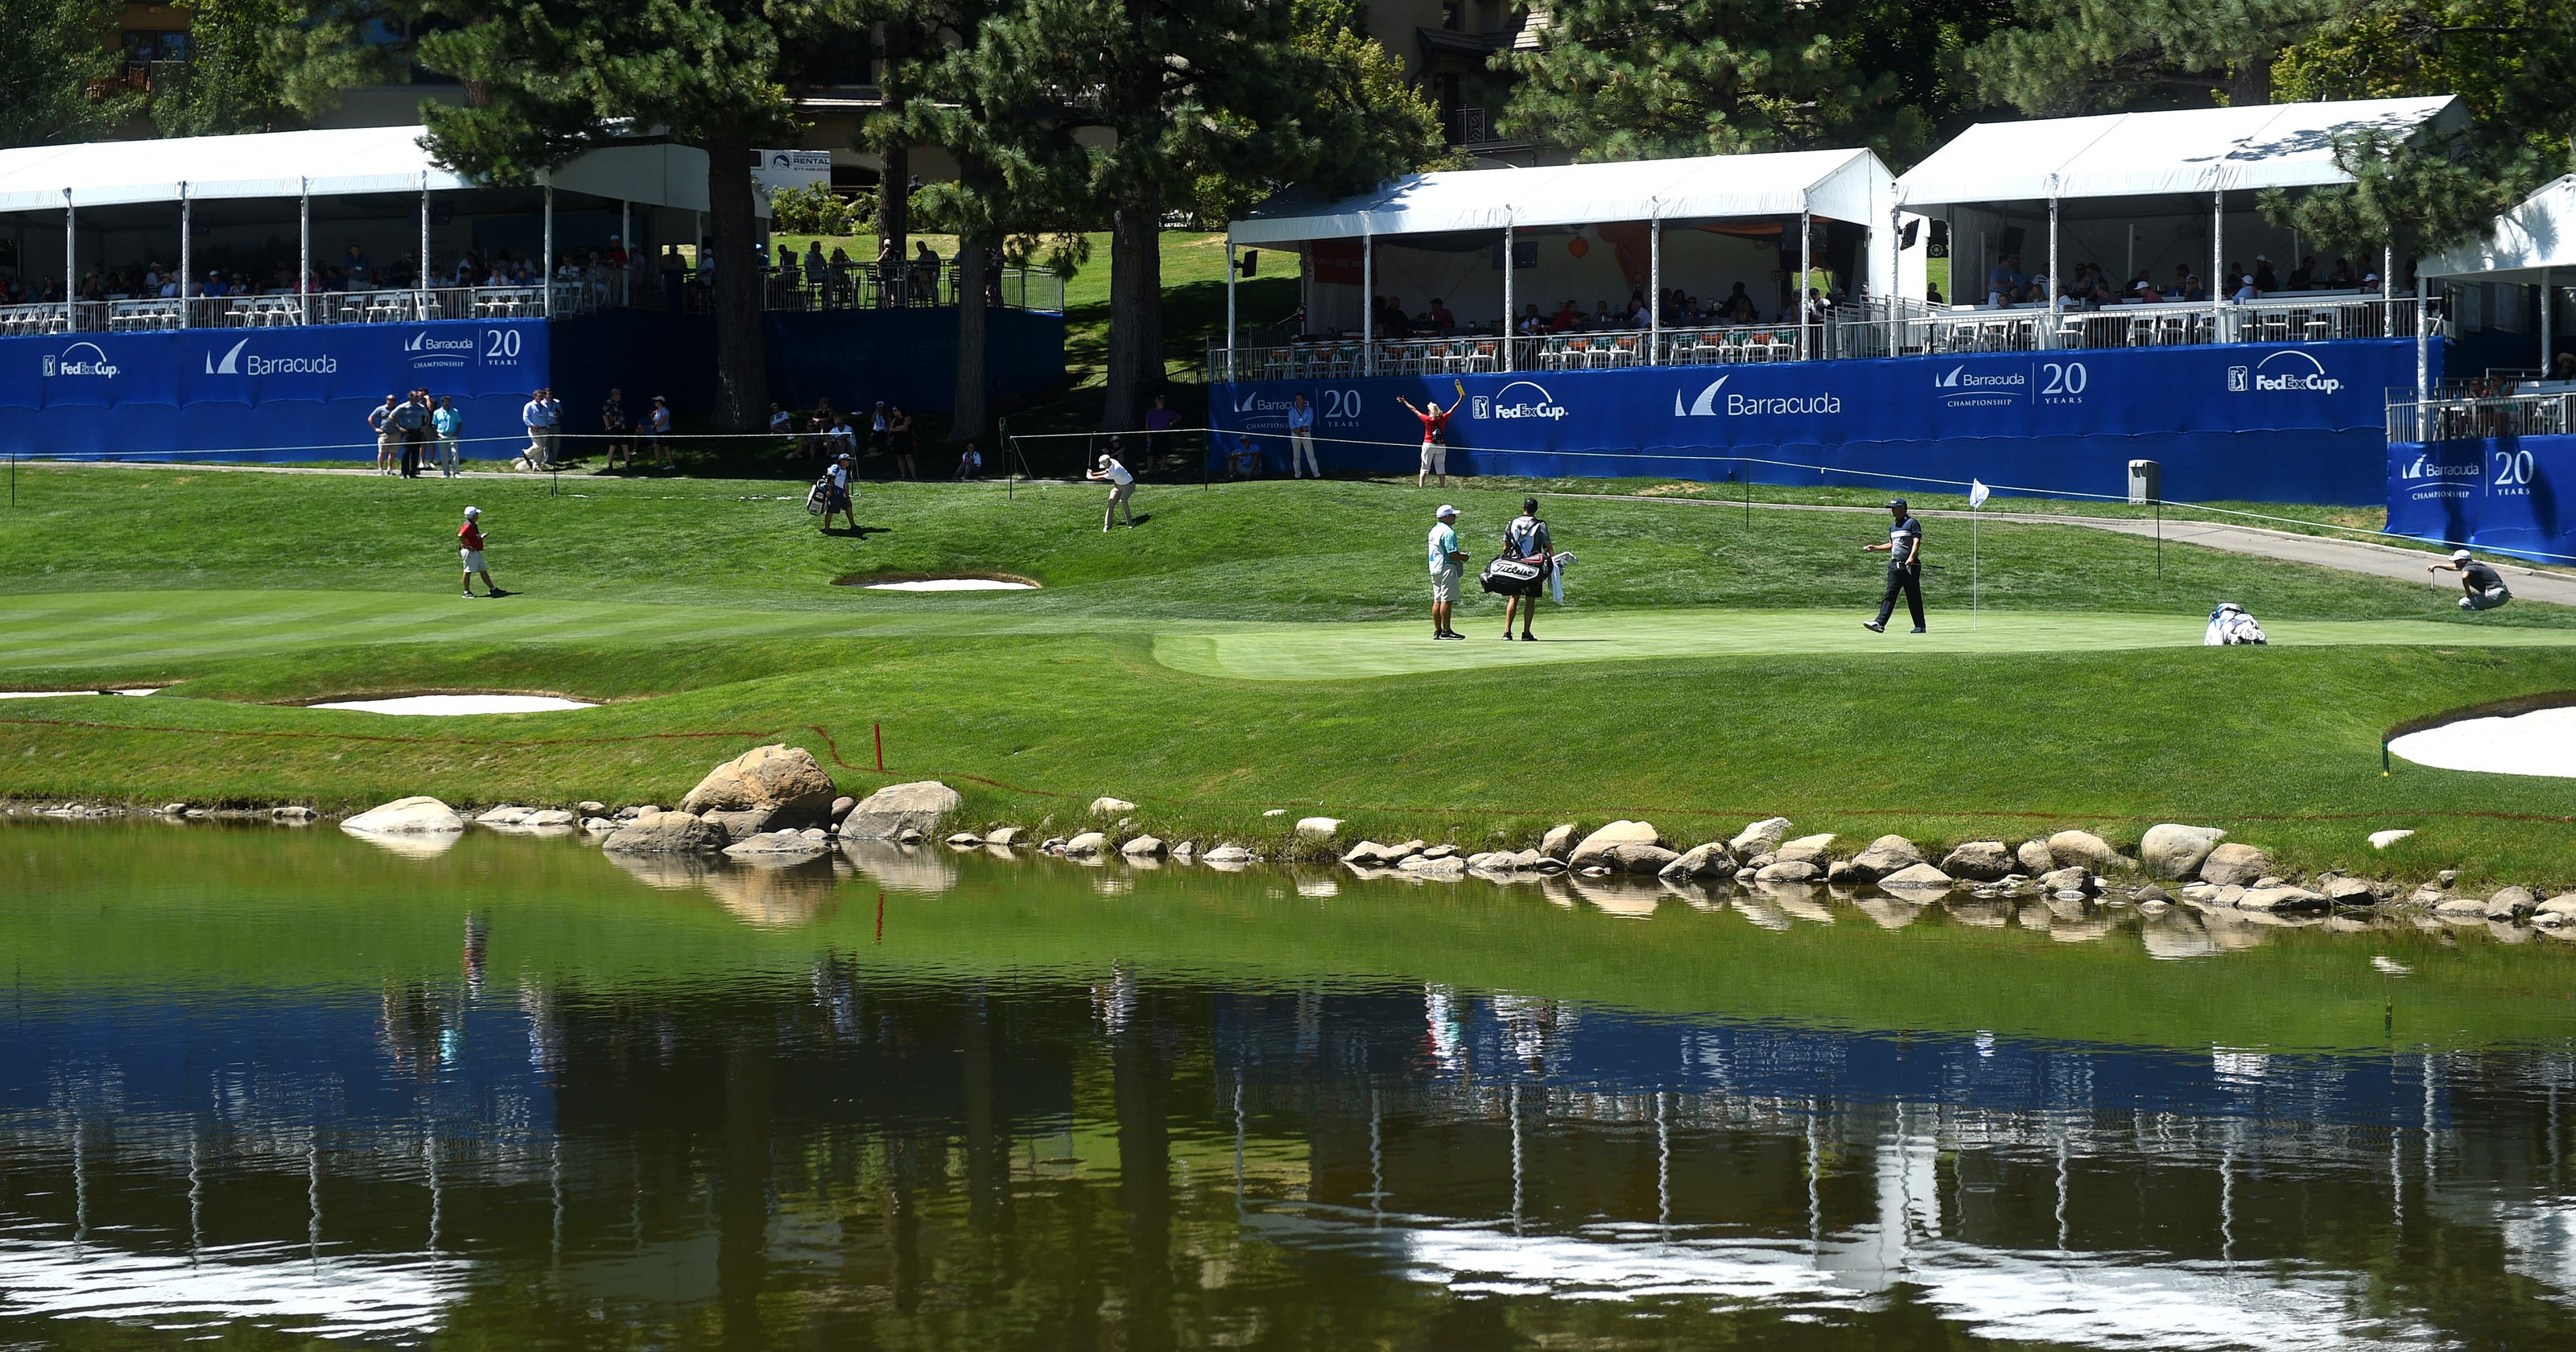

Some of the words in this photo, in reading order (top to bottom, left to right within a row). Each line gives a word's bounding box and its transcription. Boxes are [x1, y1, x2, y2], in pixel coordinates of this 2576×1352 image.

[425, 339, 473, 350] Barracuda
[486, 329, 521, 357] 20
[61, 361, 117, 379] FedExCup
[247, 354, 336, 375] Barracuda
[1963, 373, 2025, 386] Barracuda
[2041, 362, 2087, 394] 20
[2256, 373, 2339, 394] FedExCup
[1324, 390, 1361, 418] 20
[1495, 402, 1566, 421] FedExCup
[1728, 392, 1840, 416] Barracuda
[1947, 399, 2013, 407] CHAMPIONSHIP
[2426, 464, 2479, 476] Barracuda
[2495, 450, 2534, 484] 20
[2412, 491, 2470, 500] CHAMPIONSHIP
[2497, 488, 2530, 496] YEARS
[1492, 563, 1534, 578] Titleist
